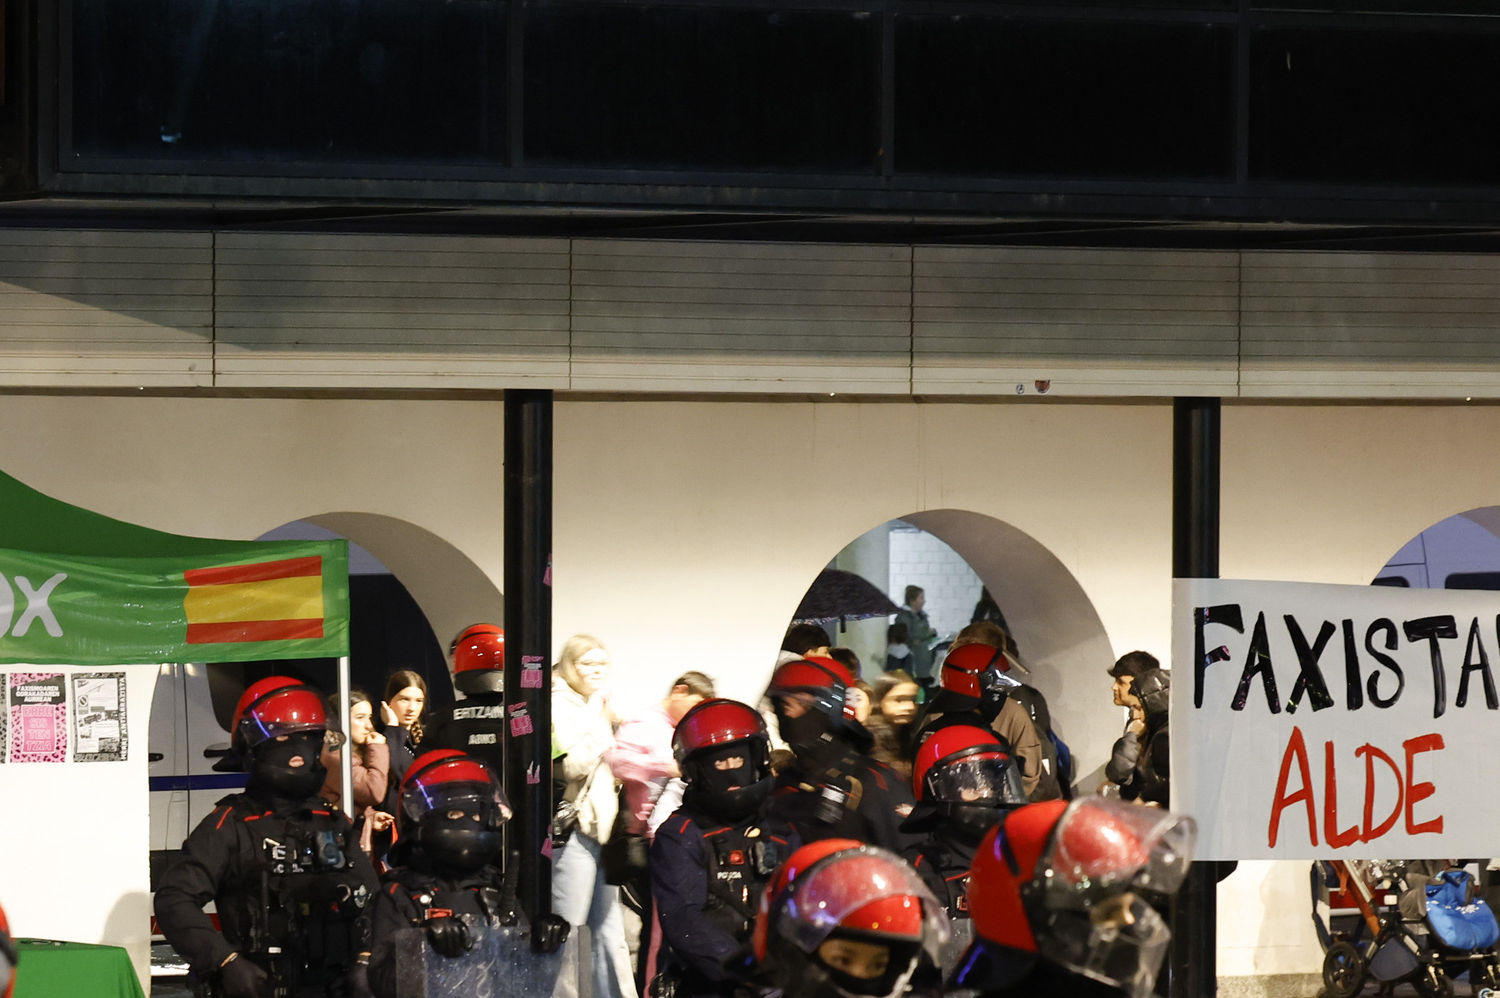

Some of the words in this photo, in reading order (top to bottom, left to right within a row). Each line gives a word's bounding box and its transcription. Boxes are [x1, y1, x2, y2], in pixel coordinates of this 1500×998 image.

[1194, 603, 1500, 718] FAXISTA
[29, 718, 48, 728] SIS
[28, 729, 51, 740] TEN
[25, 740, 52, 750] TZIA
[1268, 725, 1445, 849] ALDE
